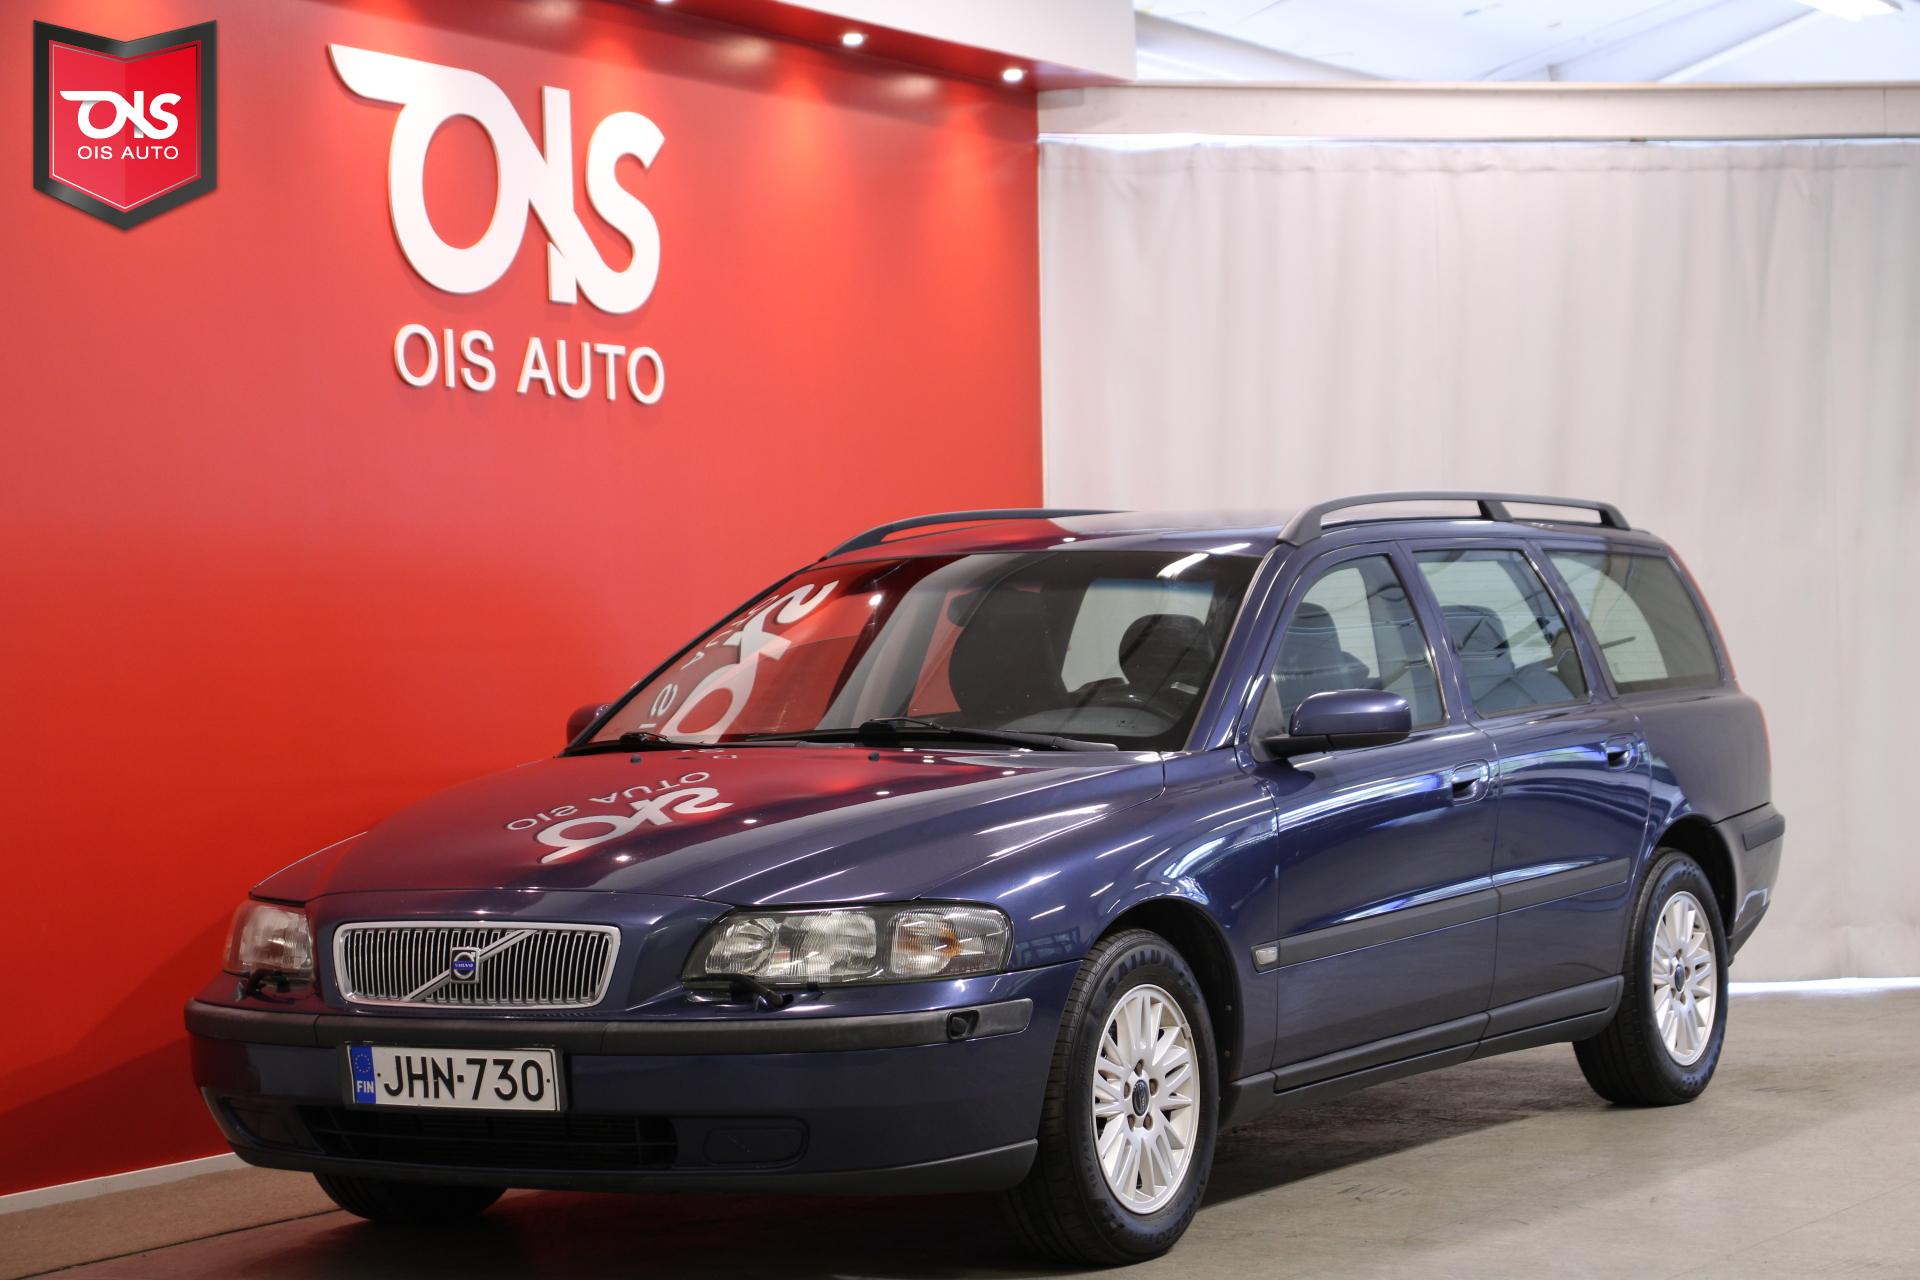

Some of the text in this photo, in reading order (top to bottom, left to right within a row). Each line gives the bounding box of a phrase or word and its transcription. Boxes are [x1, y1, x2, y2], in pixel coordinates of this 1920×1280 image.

[394, 323, 665, 405] OIS AUTO
[1104, 949, 1175, 998] SAILUN
[356, 1080, 375, 1094] FIN
[383, 1055, 545, 1102] JHN-730
